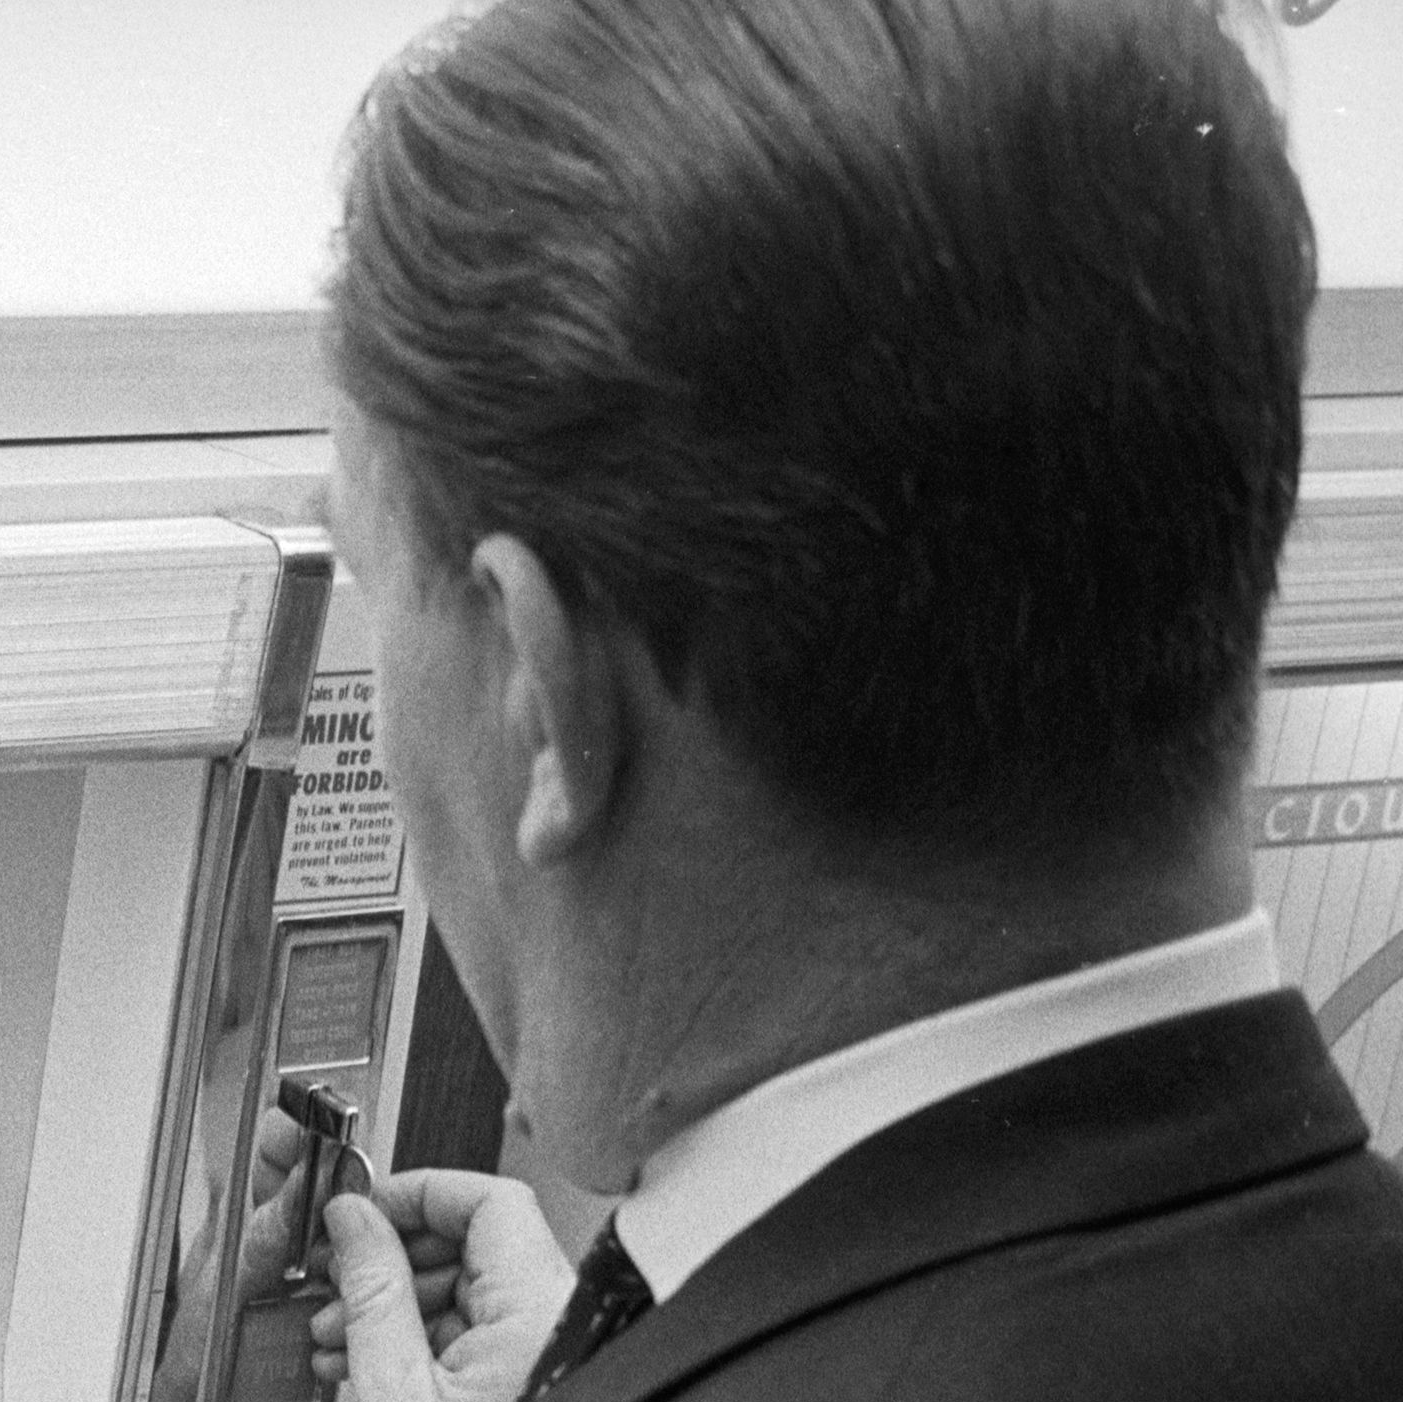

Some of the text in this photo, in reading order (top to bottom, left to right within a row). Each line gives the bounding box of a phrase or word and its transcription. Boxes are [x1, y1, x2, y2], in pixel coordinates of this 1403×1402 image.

[353, 681, 374, 703] Cig
[336, 748, 372, 766] are
[294, 769, 389, 796] FORBIDD
[338, 801, 355, 814] We
[295, 821, 317, 836] this
[348, 816, 394, 832] Parents
[292, 833, 392, 853] are urged to help
[287, 854, 331, 872] prevent
